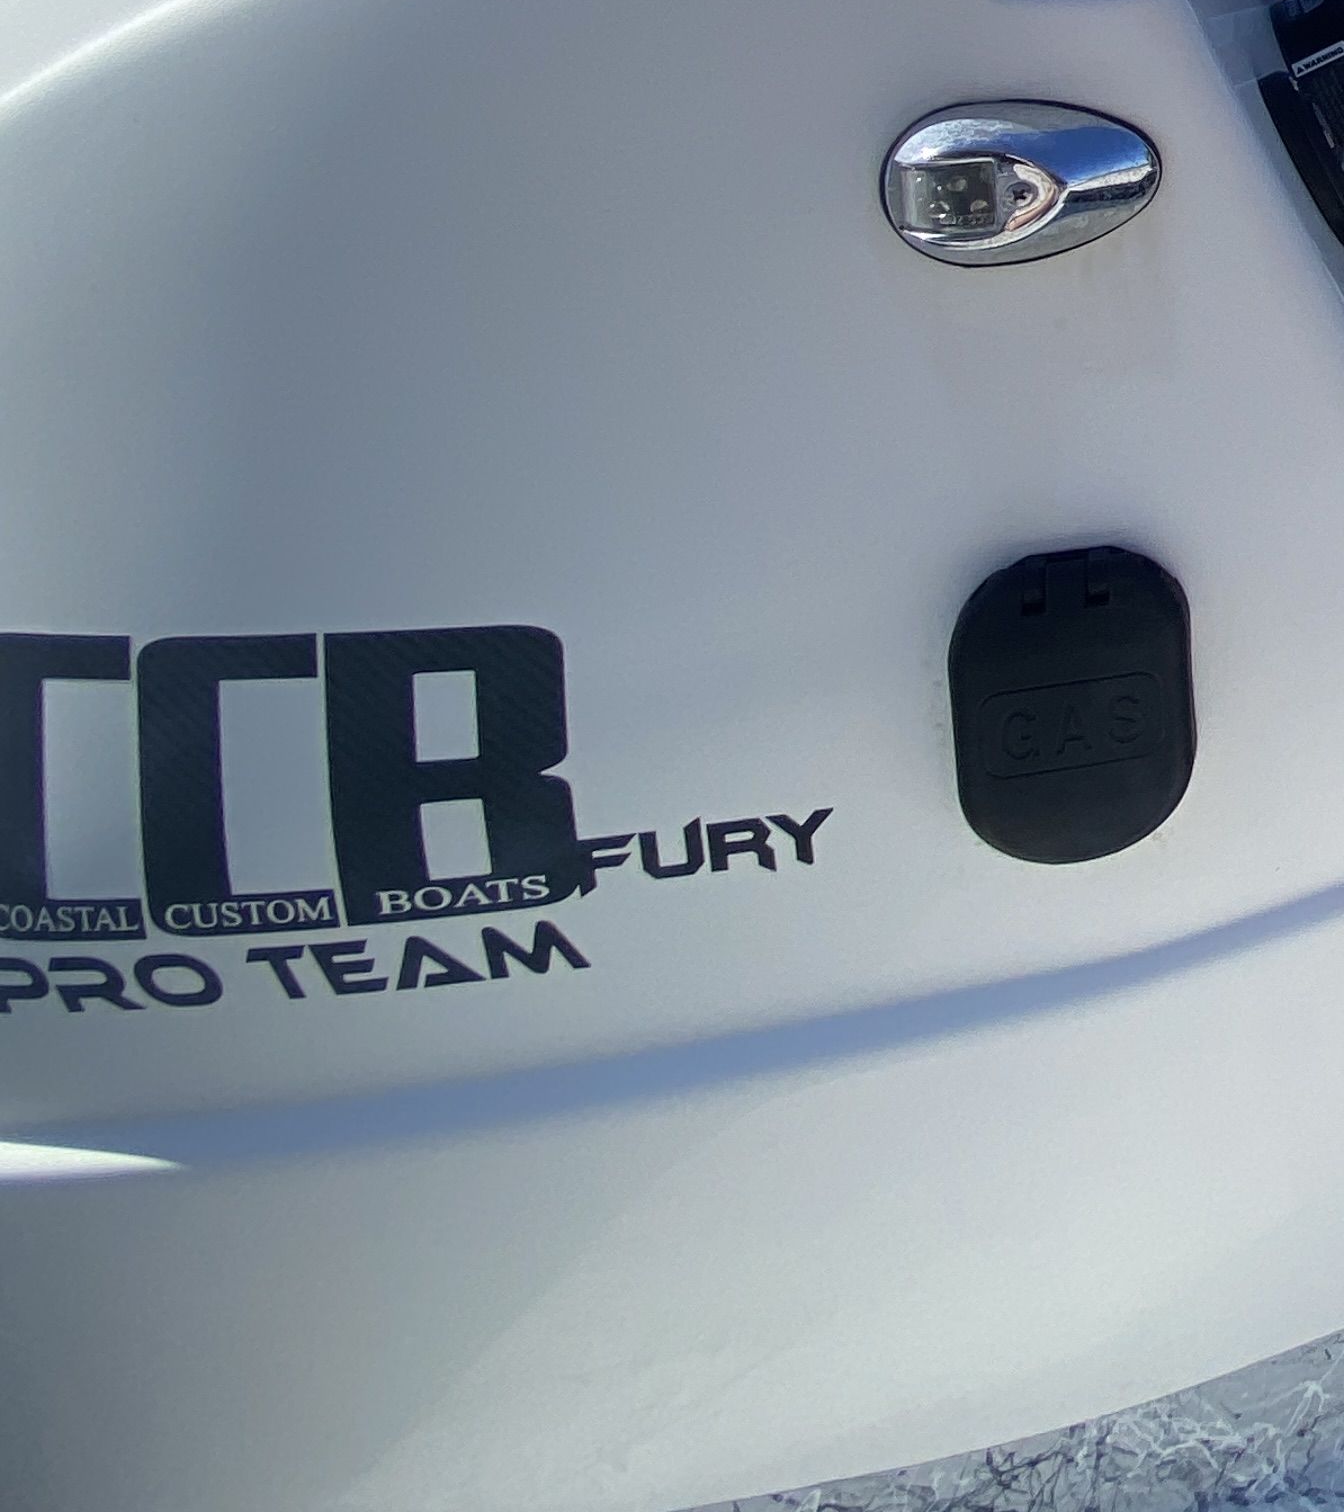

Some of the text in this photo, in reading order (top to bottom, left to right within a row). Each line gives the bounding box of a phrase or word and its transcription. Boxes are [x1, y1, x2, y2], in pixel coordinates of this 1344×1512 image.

[1003, 694, 1146, 760] GAS
[575, 808, 834, 898] FURY
[164, 896, 335, 929] CUSTOM
[376, 874, 551, 916] BOATS
[0, 920, 591, 1014] PRO TEAM
